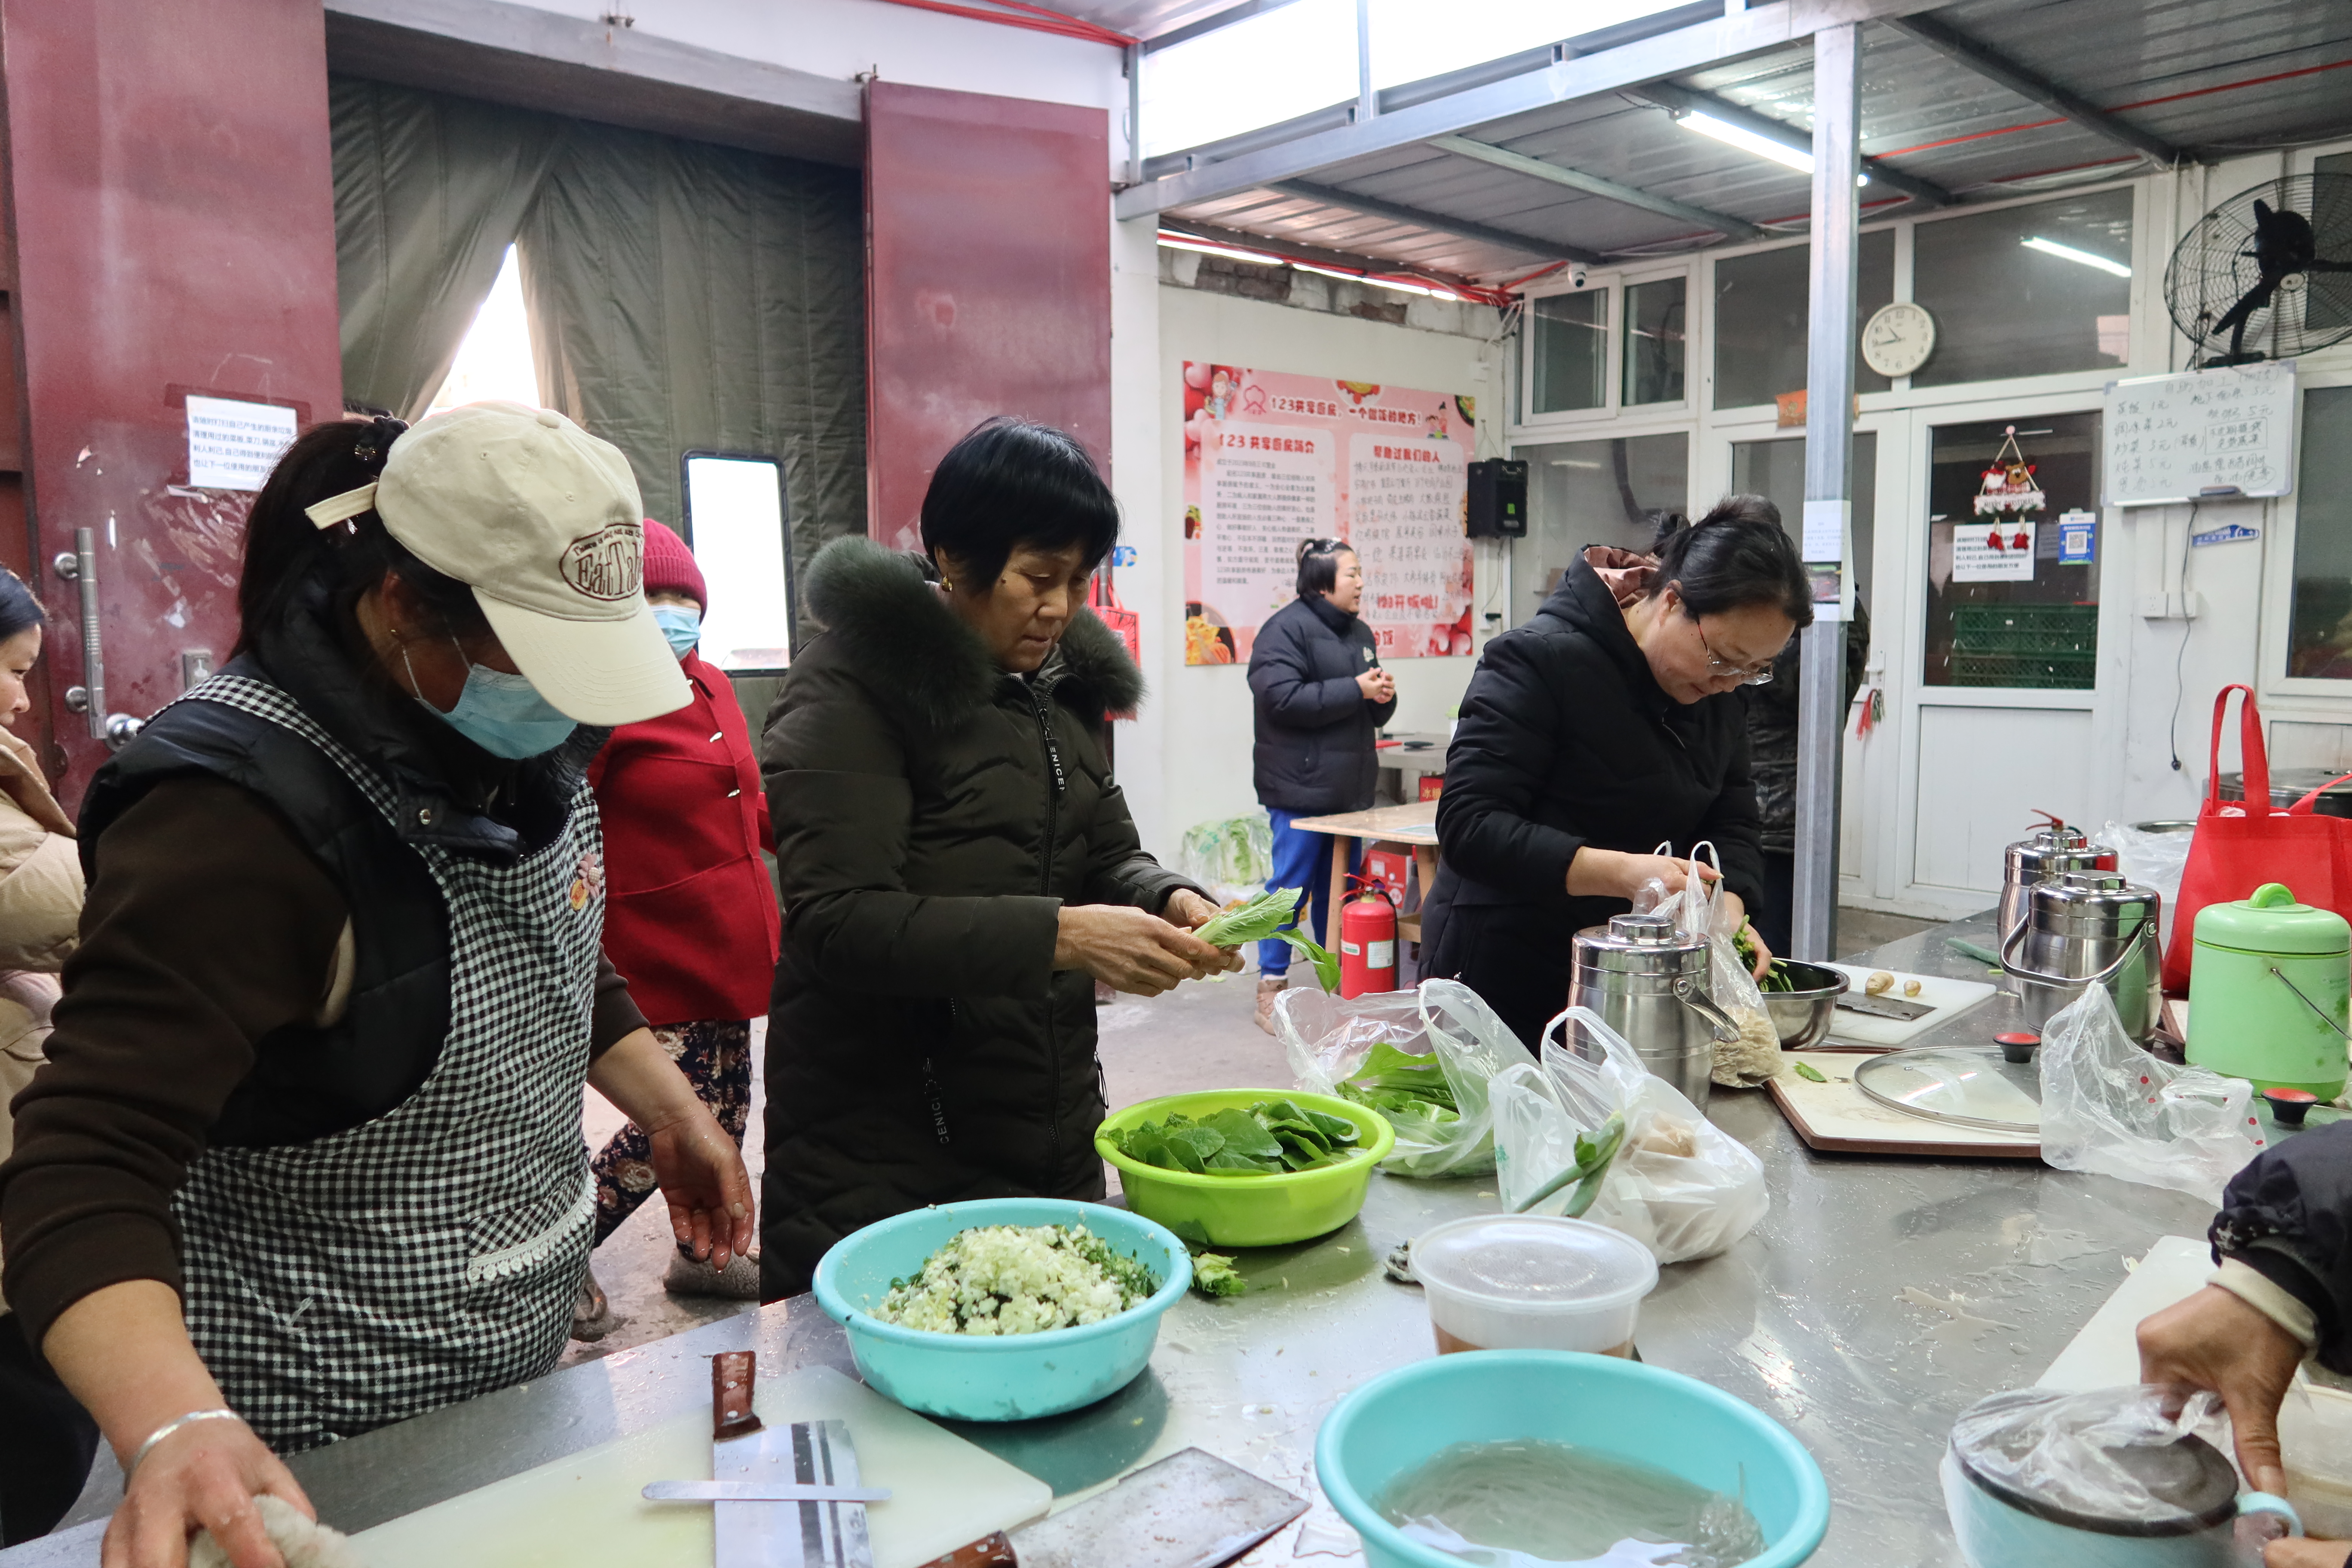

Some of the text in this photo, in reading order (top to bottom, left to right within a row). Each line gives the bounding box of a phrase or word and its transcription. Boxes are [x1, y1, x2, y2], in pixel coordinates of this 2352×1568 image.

[1220, 433, 1245, 448] 123
[1374, 445, 1440, 462] 帮助过我们的人
